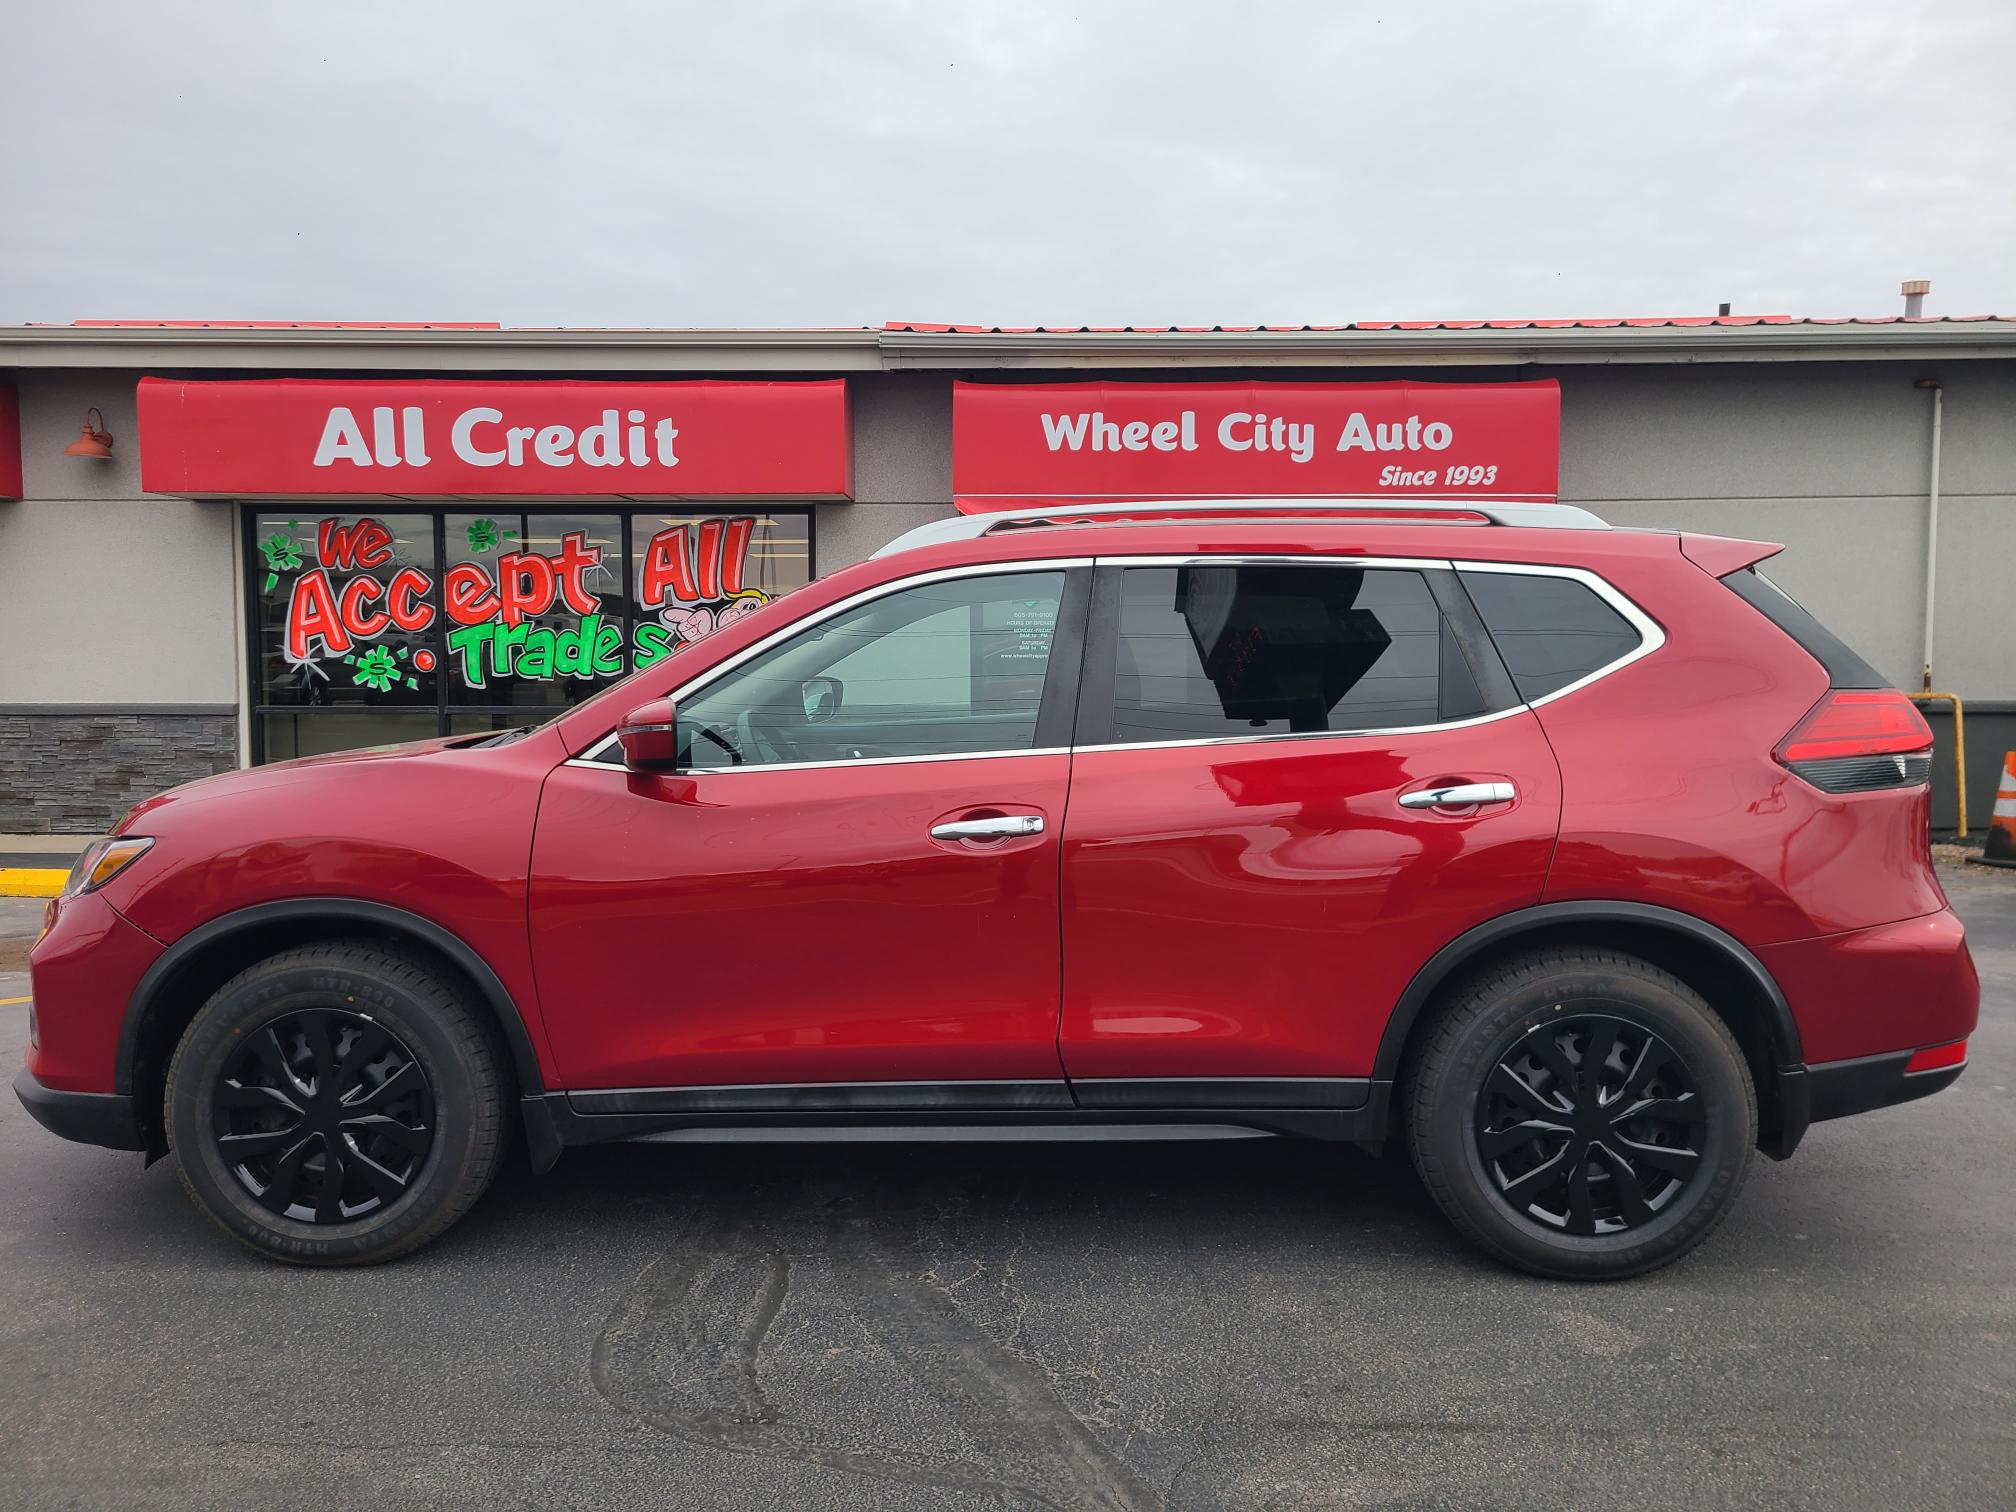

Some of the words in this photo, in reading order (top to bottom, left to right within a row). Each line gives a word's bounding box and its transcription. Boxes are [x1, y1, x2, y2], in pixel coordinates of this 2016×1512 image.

[313, 406, 431, 467] All
[451, 406, 680, 467] Credit
[1040, 410, 1199, 451] Wheel
[1217, 411, 1315, 463] City
[1336, 411, 1453, 451] Auto
[1378, 465, 1437, 486] Since
[1444, 465, 1498, 486] 1993
[316, 517, 394, 571] We
[285, 530, 603, 663] Accept
[641, 517, 757, 610] All
[447, 613, 673, 689] Trades
